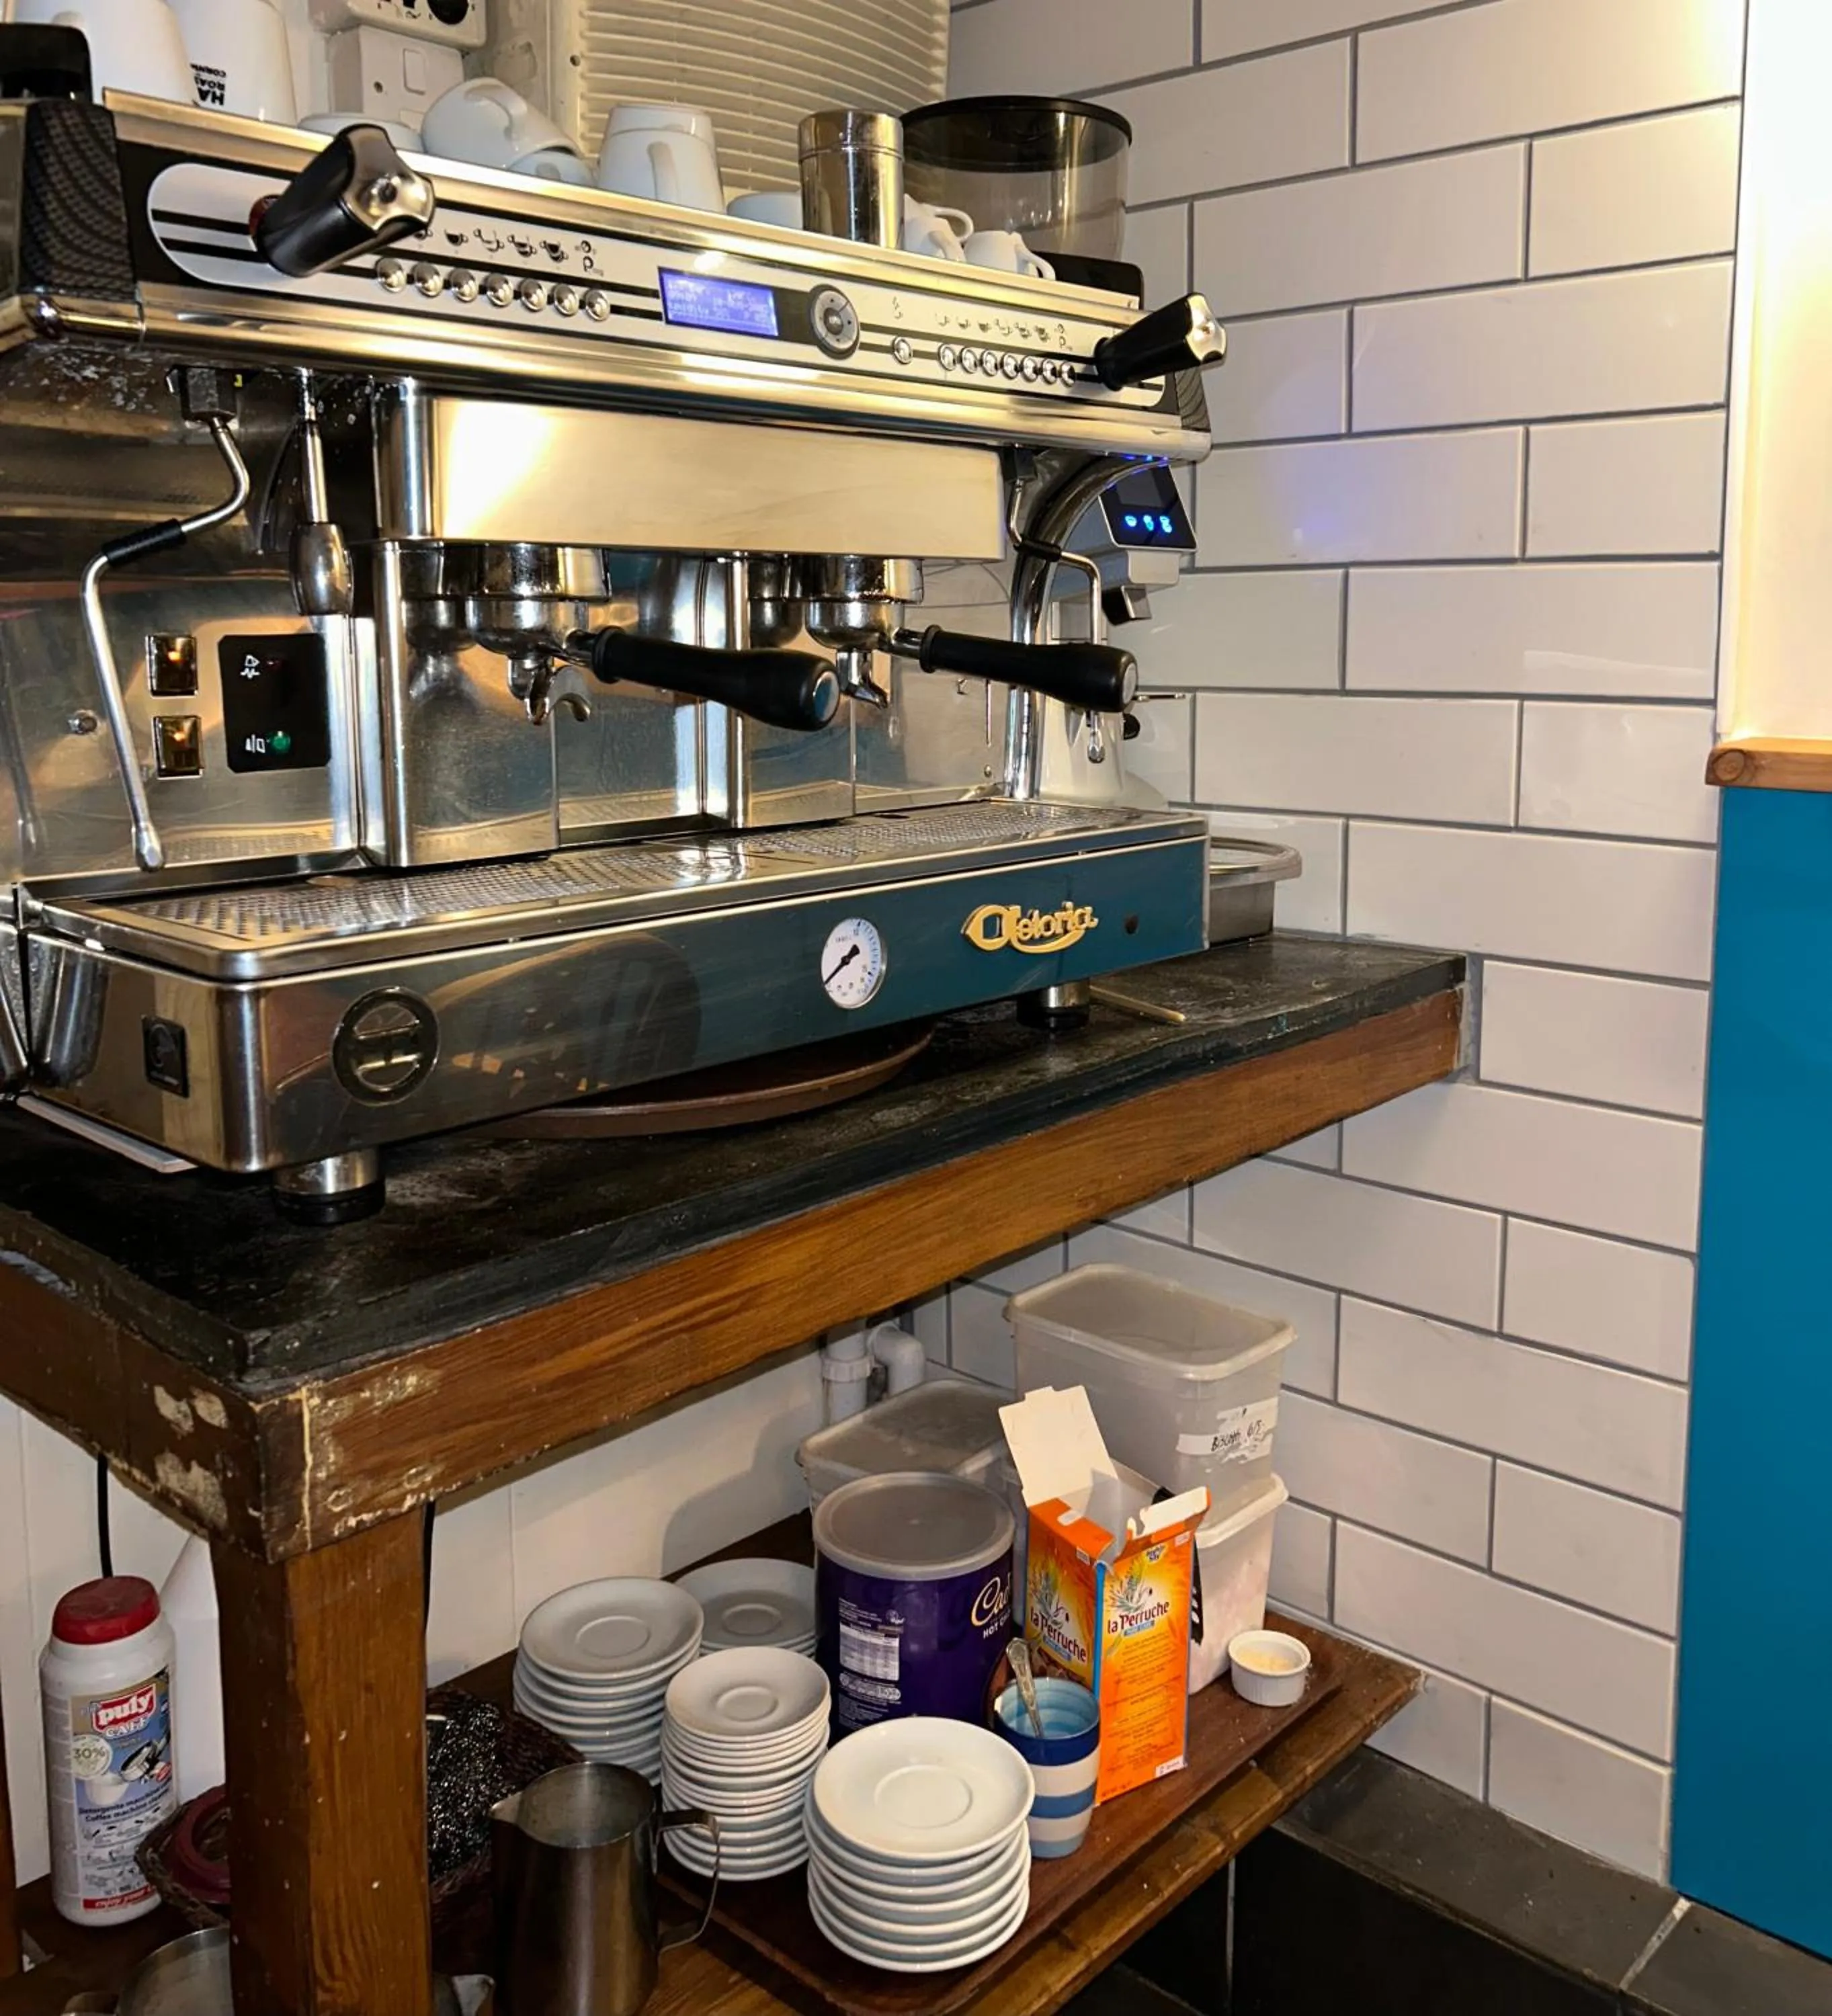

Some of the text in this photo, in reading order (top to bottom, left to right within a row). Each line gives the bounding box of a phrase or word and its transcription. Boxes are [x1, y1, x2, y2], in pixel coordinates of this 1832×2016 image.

[1031, 1607, 1039, 1627] la
[1041, 1612, 1087, 1663] Perruche
[1108, 1620, 1118, 1635] la
[1120, 1601, 1169, 1630] Perruche
[98, 1694, 151, 1726] puly
